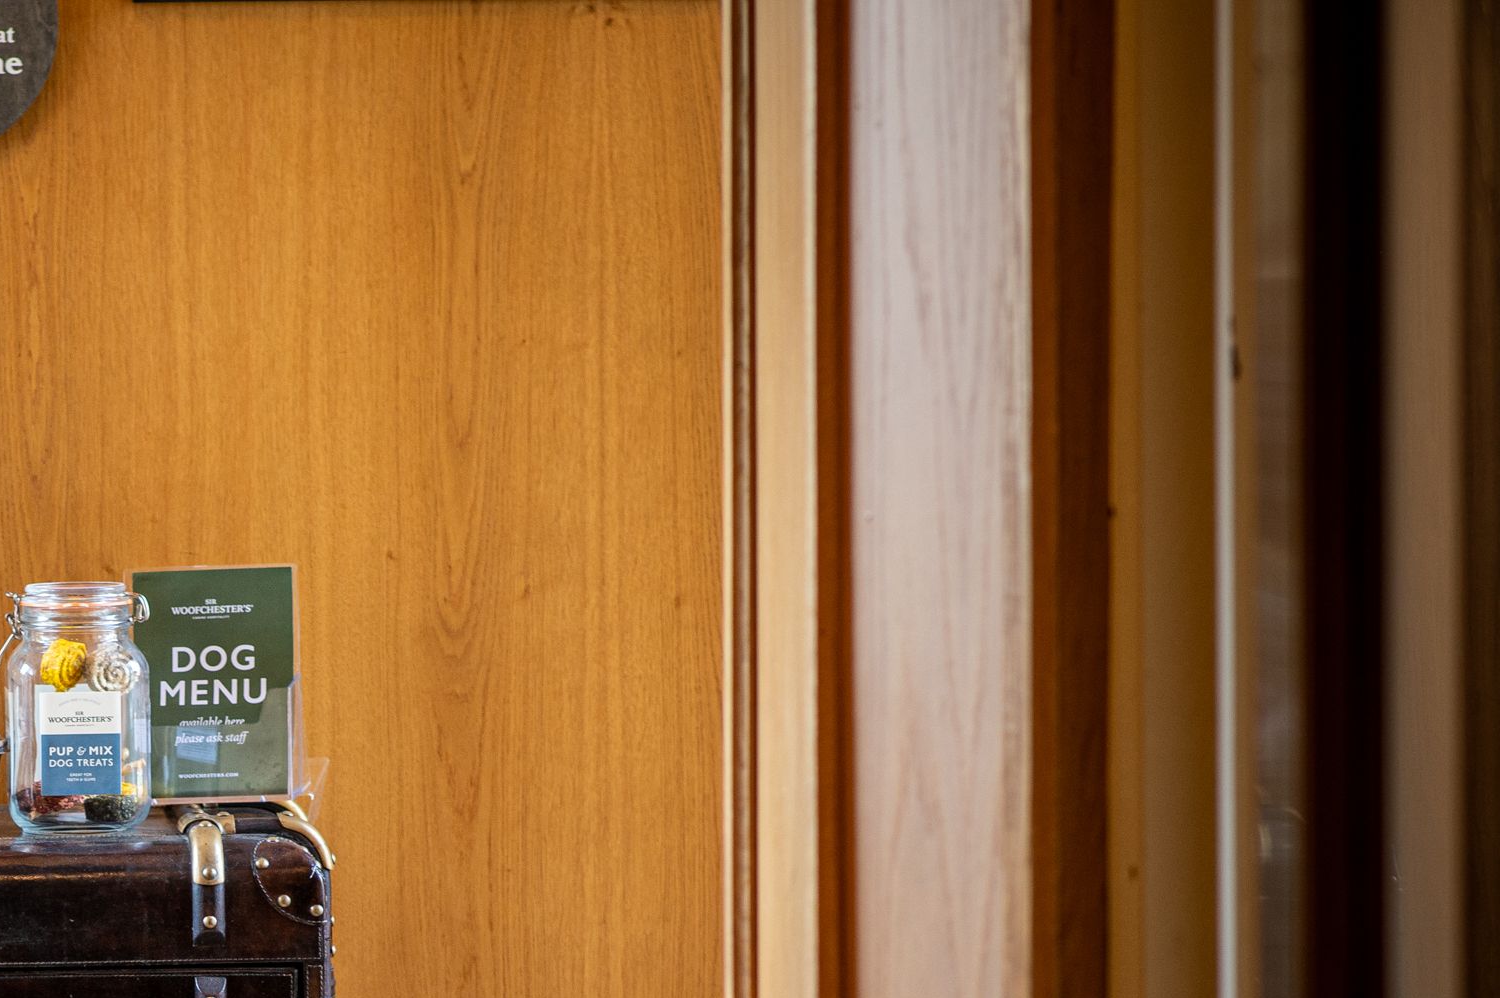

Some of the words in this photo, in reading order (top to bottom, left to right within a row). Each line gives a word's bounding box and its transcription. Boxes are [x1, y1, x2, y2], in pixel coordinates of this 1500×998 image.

[172, 644, 256, 673] DOG
[159, 677, 268, 707] MENU
[179, 716, 223, 727] available
[224, 716, 245, 726] here
[174, 732, 204, 746] please
[206, 731, 223, 742] ask
[225, 730, 250, 744] staff
[49, 746, 74, 756] PUP
[76, 746, 87, 756] &
[88, 746, 113, 756] MIX
[49, 759, 73, 768] DOG
[76, 758, 114, 767] TREATS
